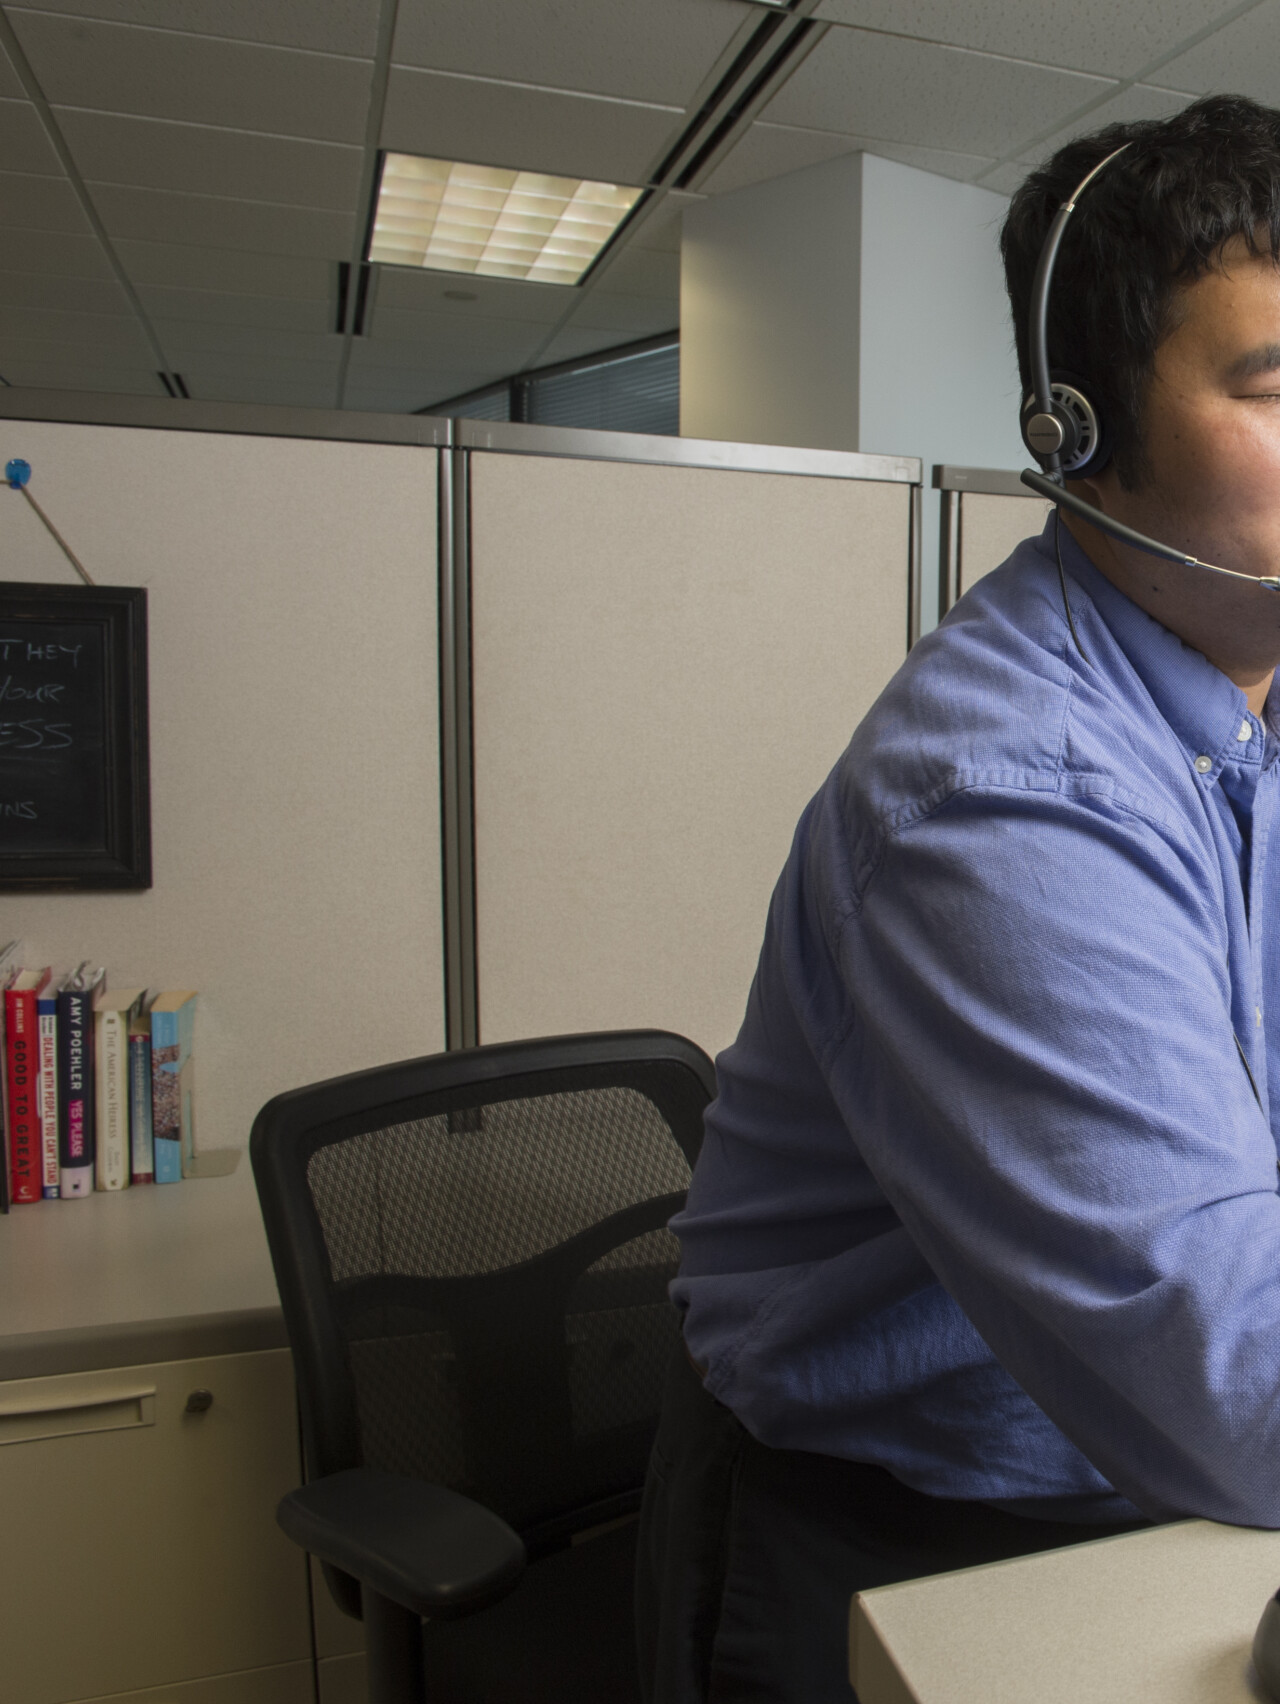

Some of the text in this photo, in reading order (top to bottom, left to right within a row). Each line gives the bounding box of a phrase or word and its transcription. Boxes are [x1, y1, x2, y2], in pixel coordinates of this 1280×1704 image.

[16, 1009, 24, 1033] COLLINS
[43, 1037, 54, 1069] DEALING
[70, 998, 82, 1090] AMY POEHLER
[106, 1030, 117, 1048] THE
[44, 1073, 54, 1090] WITH
[106, 1052, 117, 1100] AMERICAN
[14, 1040, 30, 1177] GOOD TO GREAT
[44, 1092, 55, 1118] PEOPLE
[45, 1122, 55, 1137] YOU
[70, 1100, 83, 1157] YES PLEASE
[107, 1102, 117, 1138] HEIRESS
[46, 1161, 57, 1184] STAND
